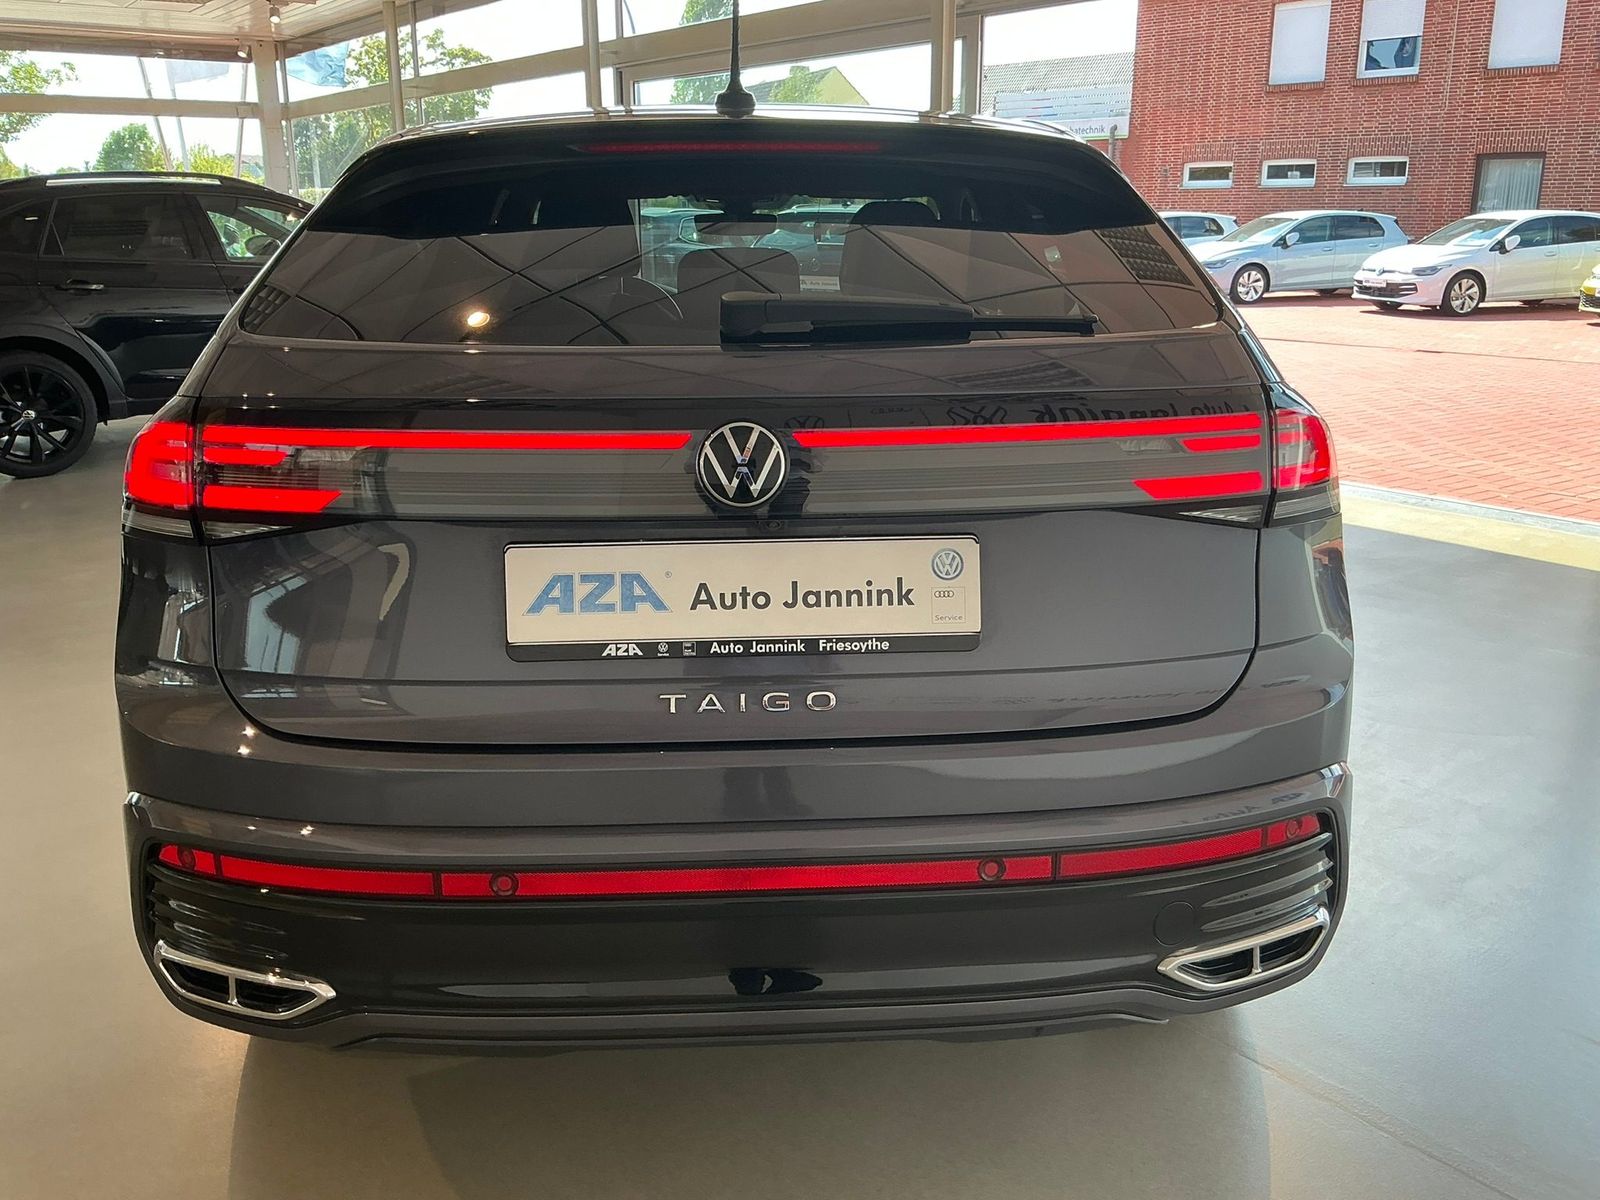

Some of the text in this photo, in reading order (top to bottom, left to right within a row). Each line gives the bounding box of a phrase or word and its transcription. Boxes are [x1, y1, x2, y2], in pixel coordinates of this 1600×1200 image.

[523, 572, 915, 616] AZA Auto Jannink
[601, 643, 644, 657] AZA
[710, 642, 744, 654] Auto
[750, 640, 806, 653] Jannink
[818, 638, 890, 652] Friesoythe
[659, 691, 837, 714] TAIGO
